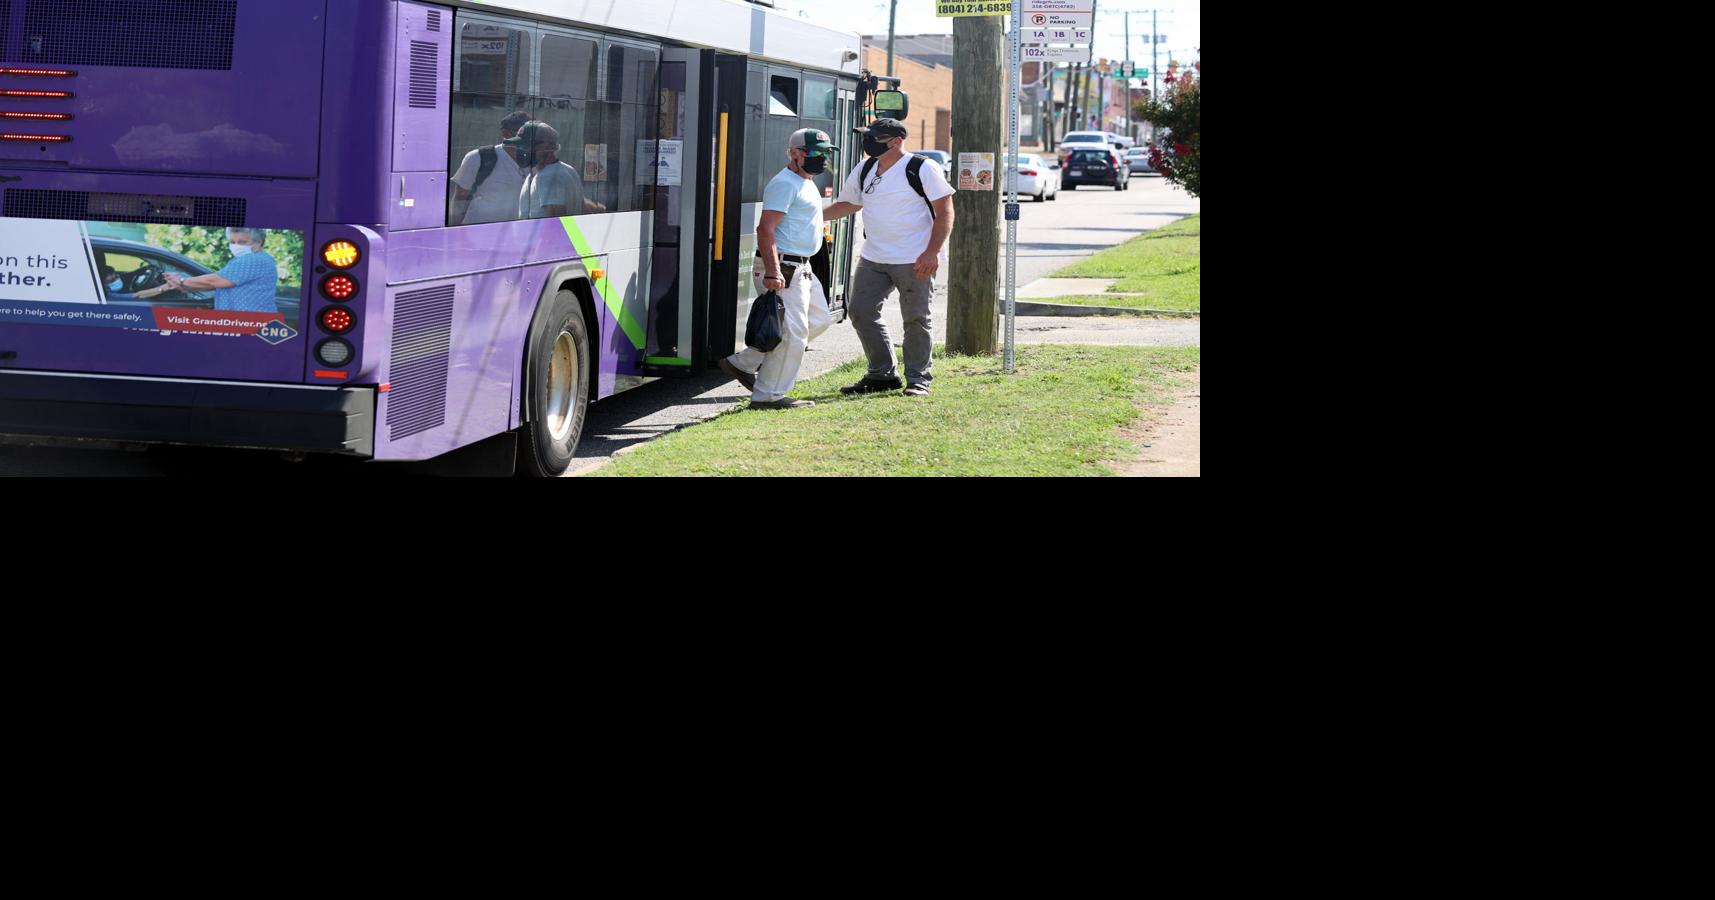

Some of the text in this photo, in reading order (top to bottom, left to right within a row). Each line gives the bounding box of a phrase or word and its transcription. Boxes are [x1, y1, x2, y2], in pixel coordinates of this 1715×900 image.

[938, 5, 965, 13] (804)
[1025, 48, 1045, 56] 102x
[26, 254, 68, 269] this
[0, 271, 51, 287] ther.
[25, 307, 46, 317] help
[47, 310, 66, 318] you
[67, 311, 83, 319] get
[85, 311, 111, 319] there
[113, 312, 142, 322] safely.
[167, 316, 268, 328] Visit GrandDriver.ne
[261, 327, 289, 337] CNG
